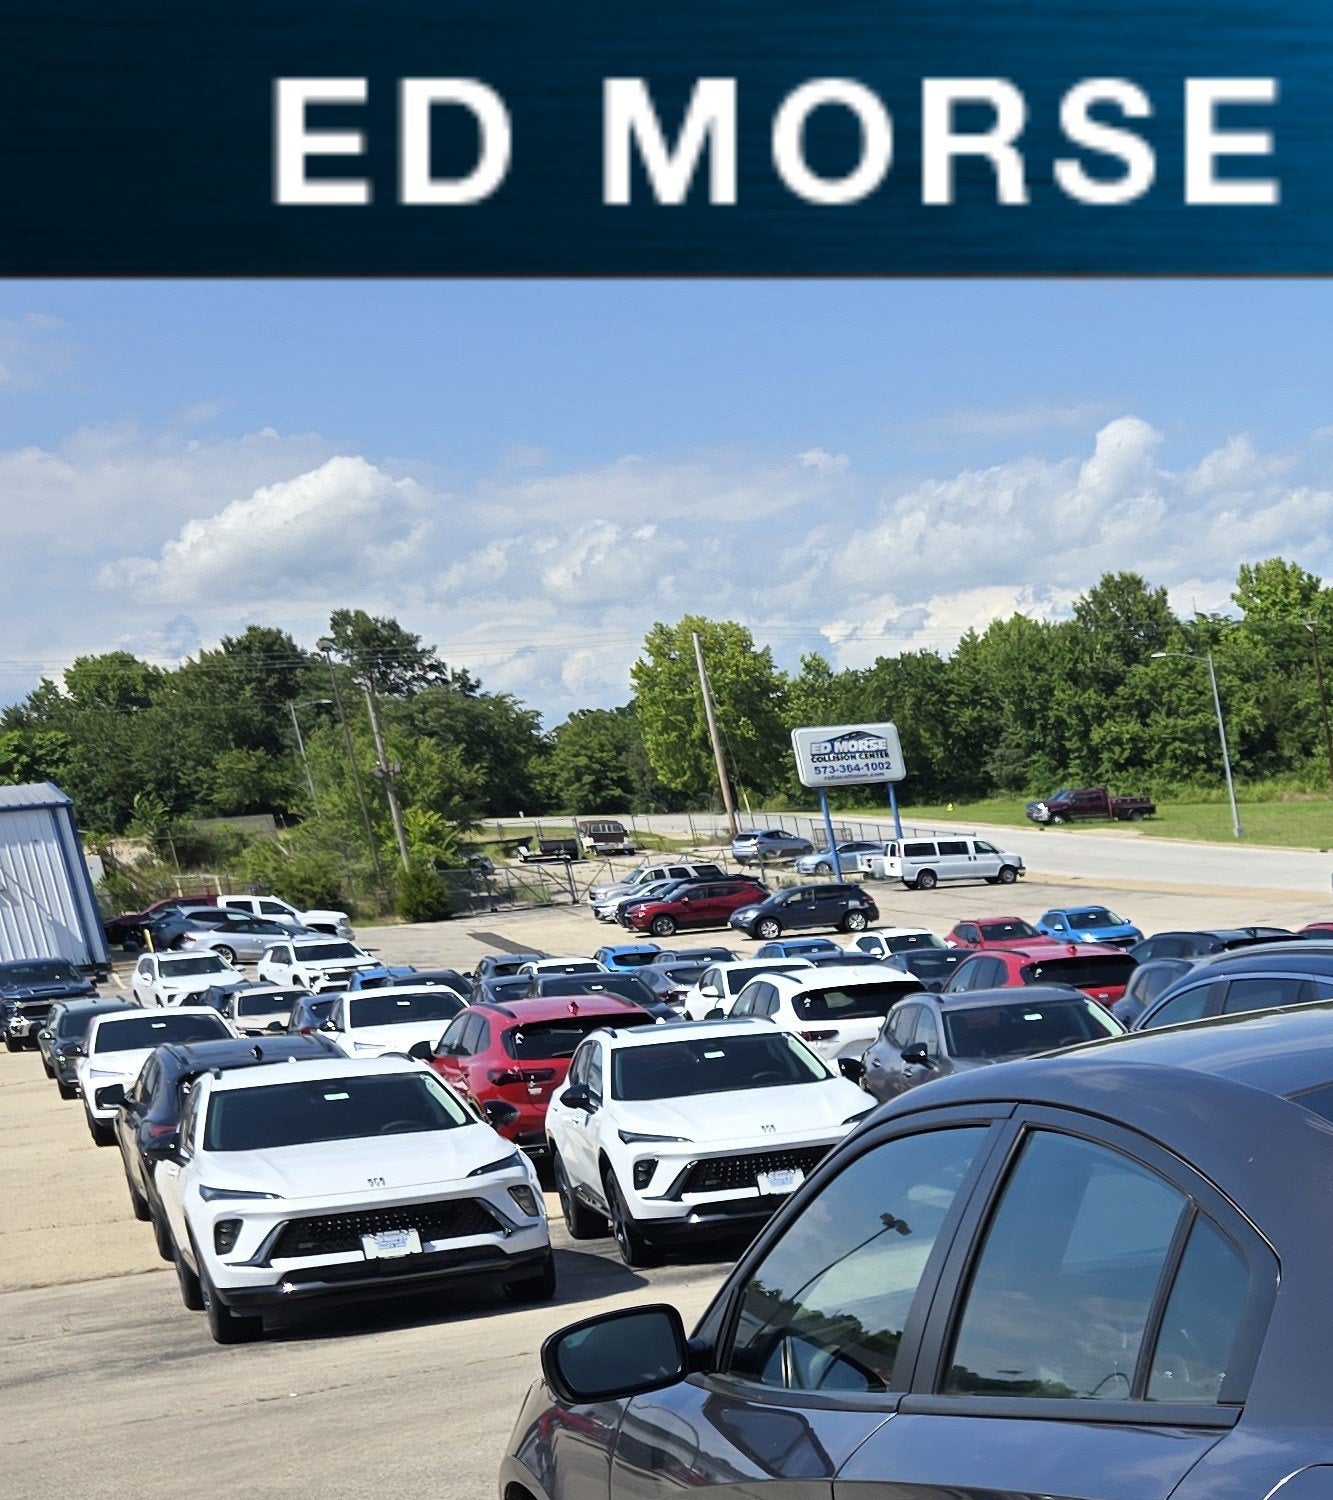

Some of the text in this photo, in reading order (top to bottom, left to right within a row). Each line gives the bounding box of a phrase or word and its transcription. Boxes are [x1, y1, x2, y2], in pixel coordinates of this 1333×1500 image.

[811, 737, 887, 755] ED MORSE
[811, 751, 890, 763] COLLISION CENTER
